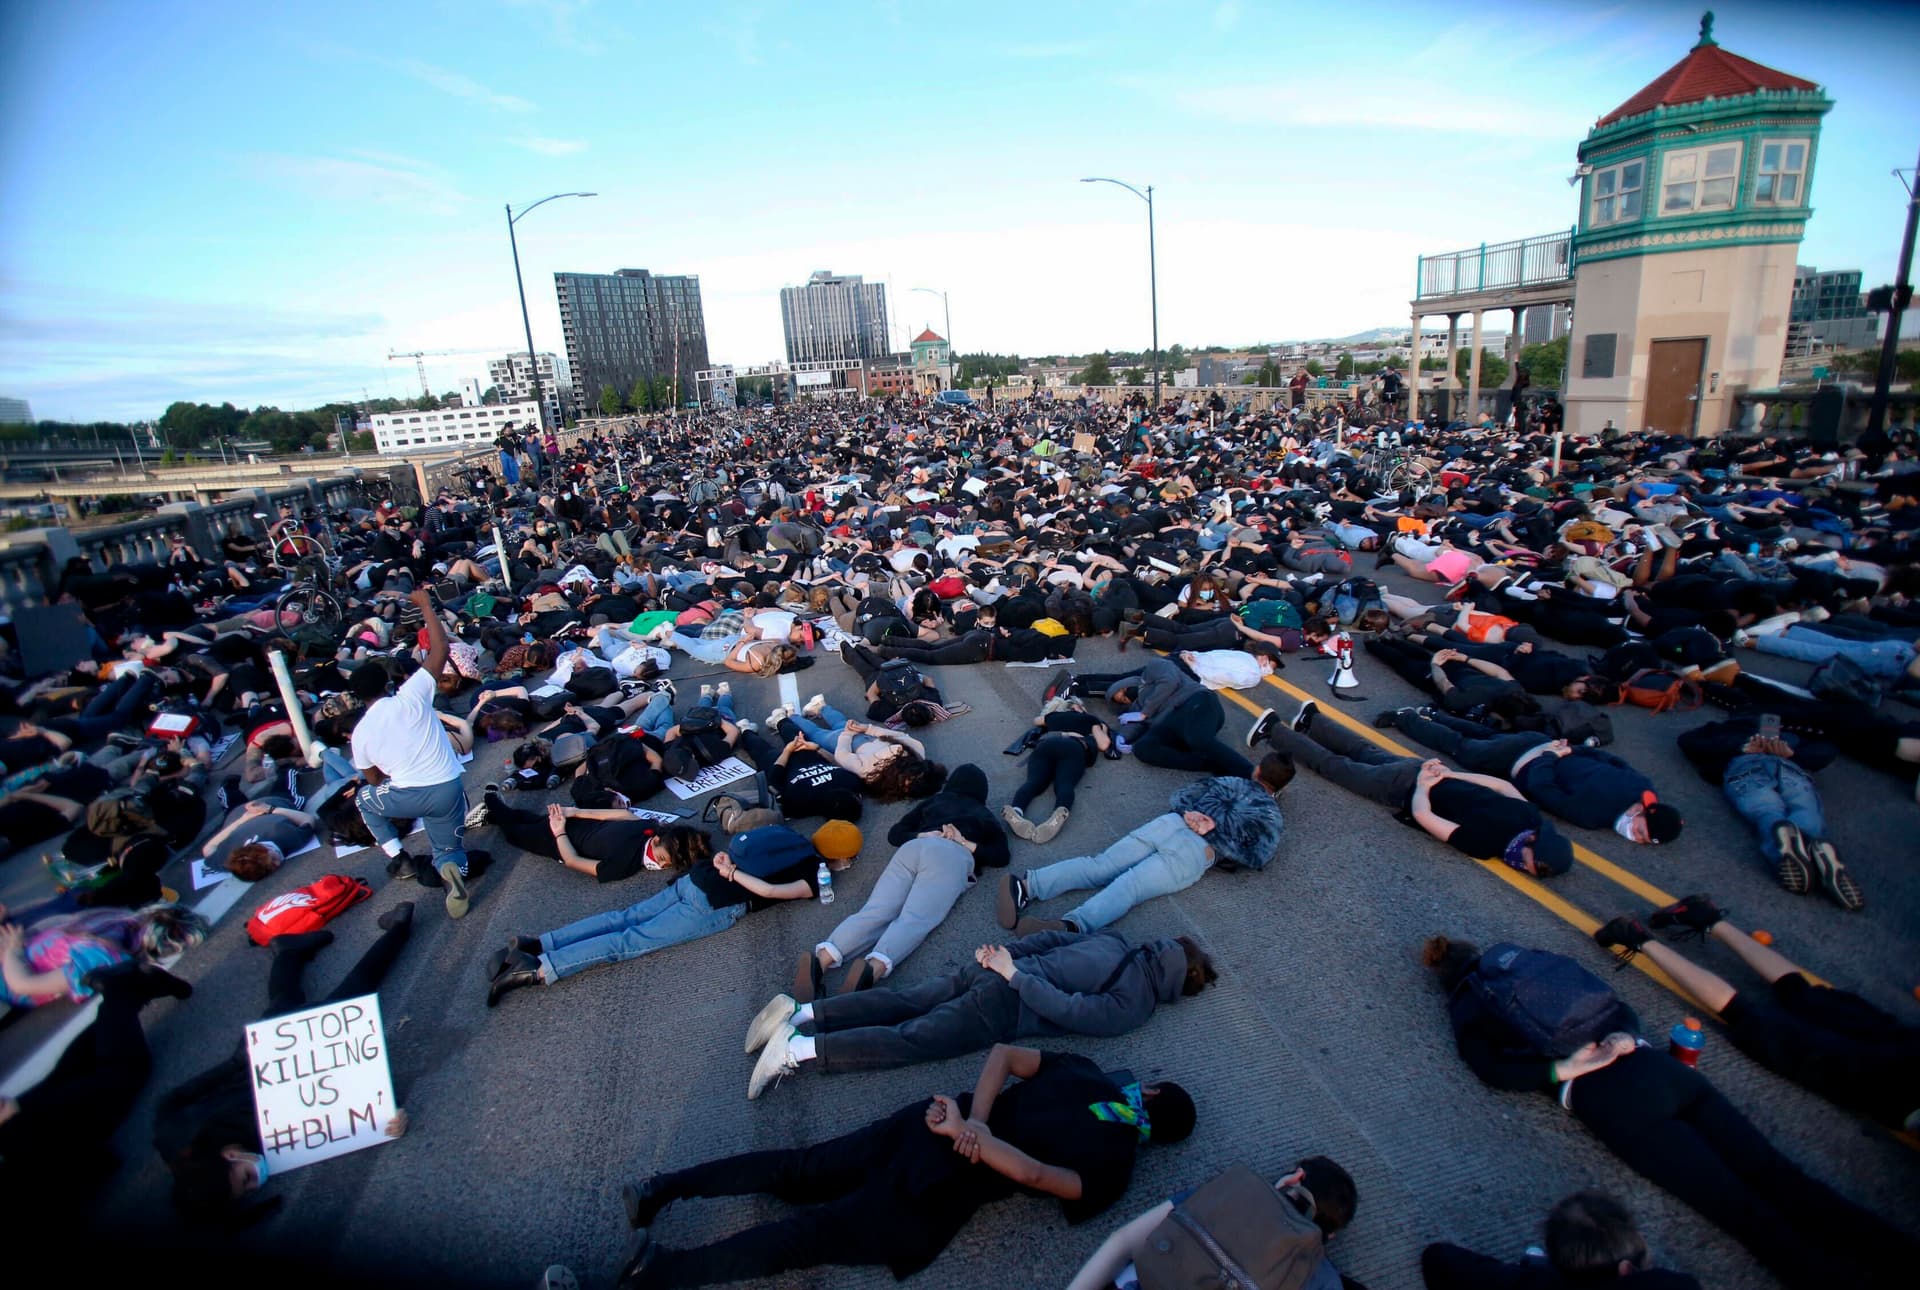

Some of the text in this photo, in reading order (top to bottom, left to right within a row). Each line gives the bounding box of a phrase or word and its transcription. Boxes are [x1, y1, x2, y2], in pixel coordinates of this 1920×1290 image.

[685, 766, 745, 793] BREATHE
[811, 773, 833, 787] ART
[274, 1004, 364, 1051] STOP
[255, 1034, 379, 1089] KILLING
[299, 1075, 339, 1107] US
[265, 1103, 377, 1154] #BLM
